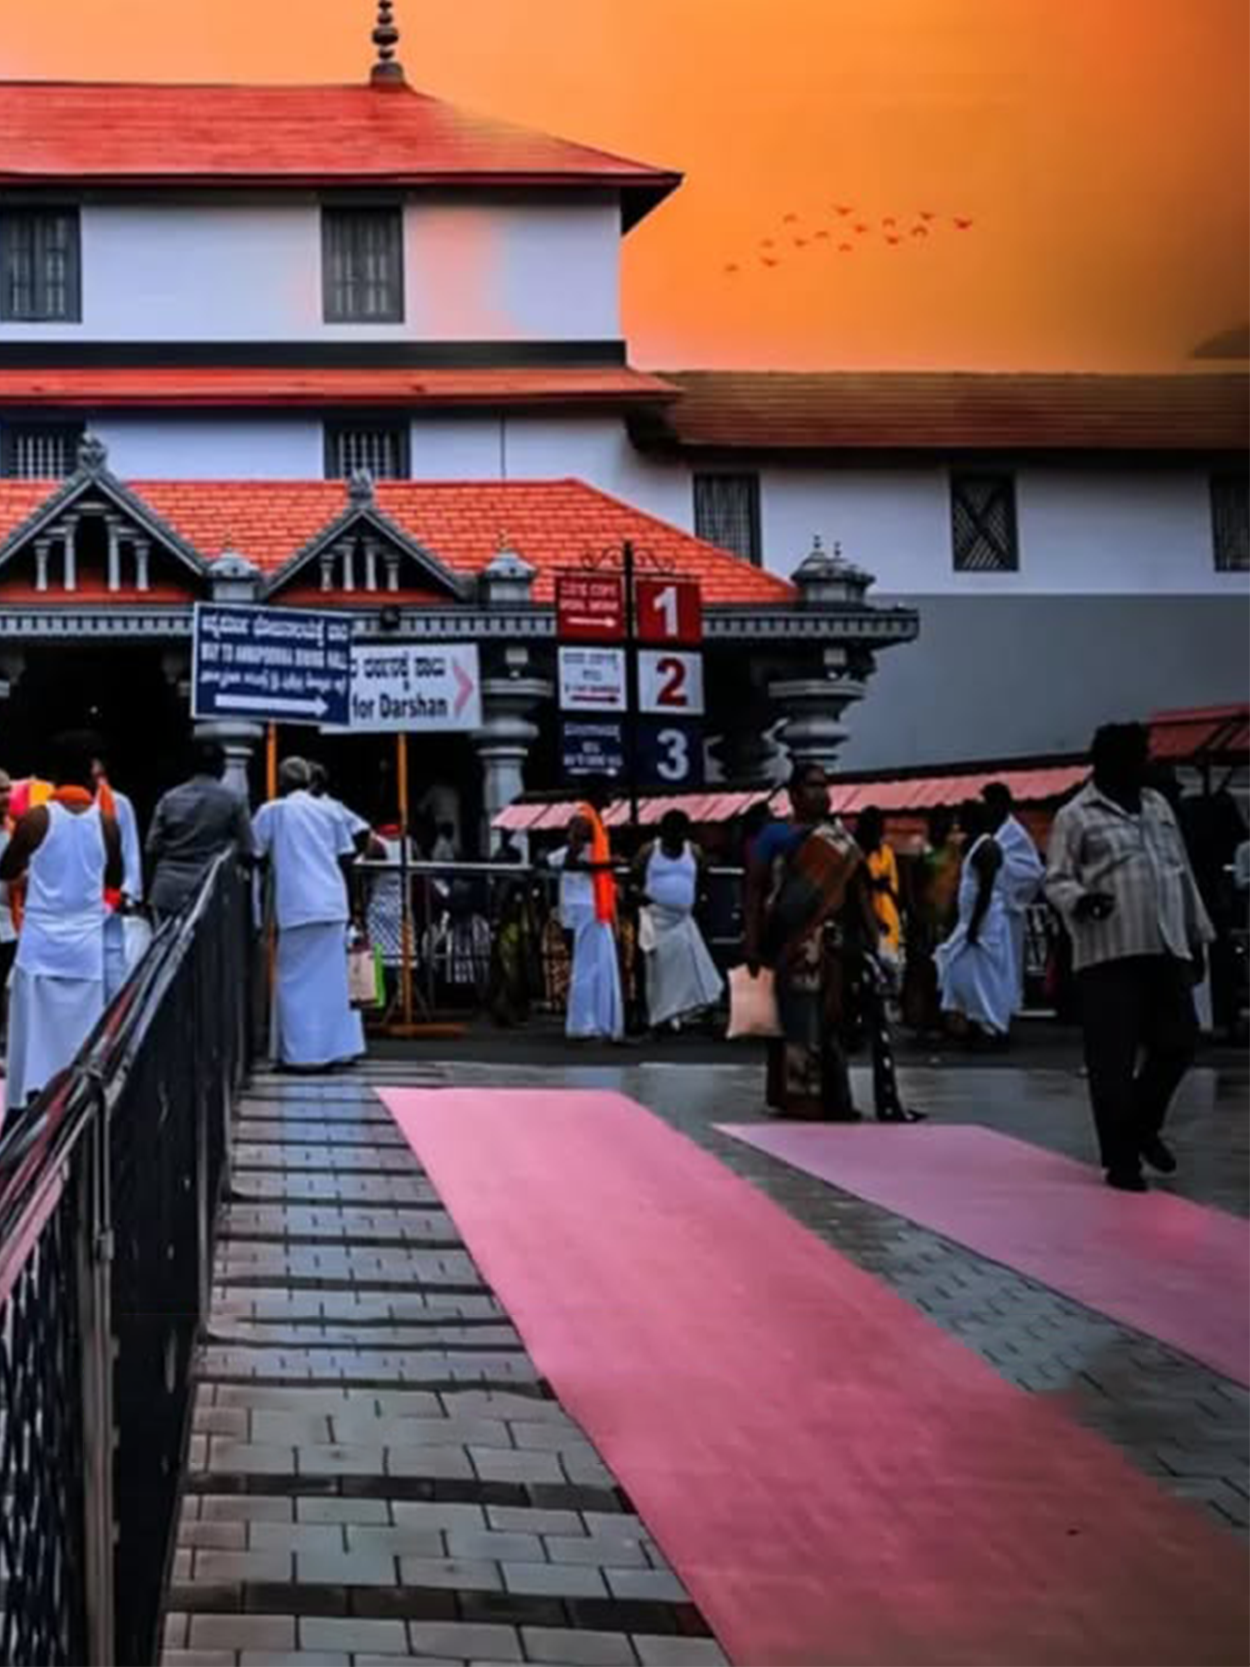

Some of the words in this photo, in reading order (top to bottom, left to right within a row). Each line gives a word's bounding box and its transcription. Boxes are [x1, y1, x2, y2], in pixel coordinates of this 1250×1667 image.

[653, 585, 678, 636] 1
[352, 692, 374, 719] for
[380, 692, 447, 720] Darshan
[656, 656, 688, 707] 2
[656, 727, 690, 781] 3
